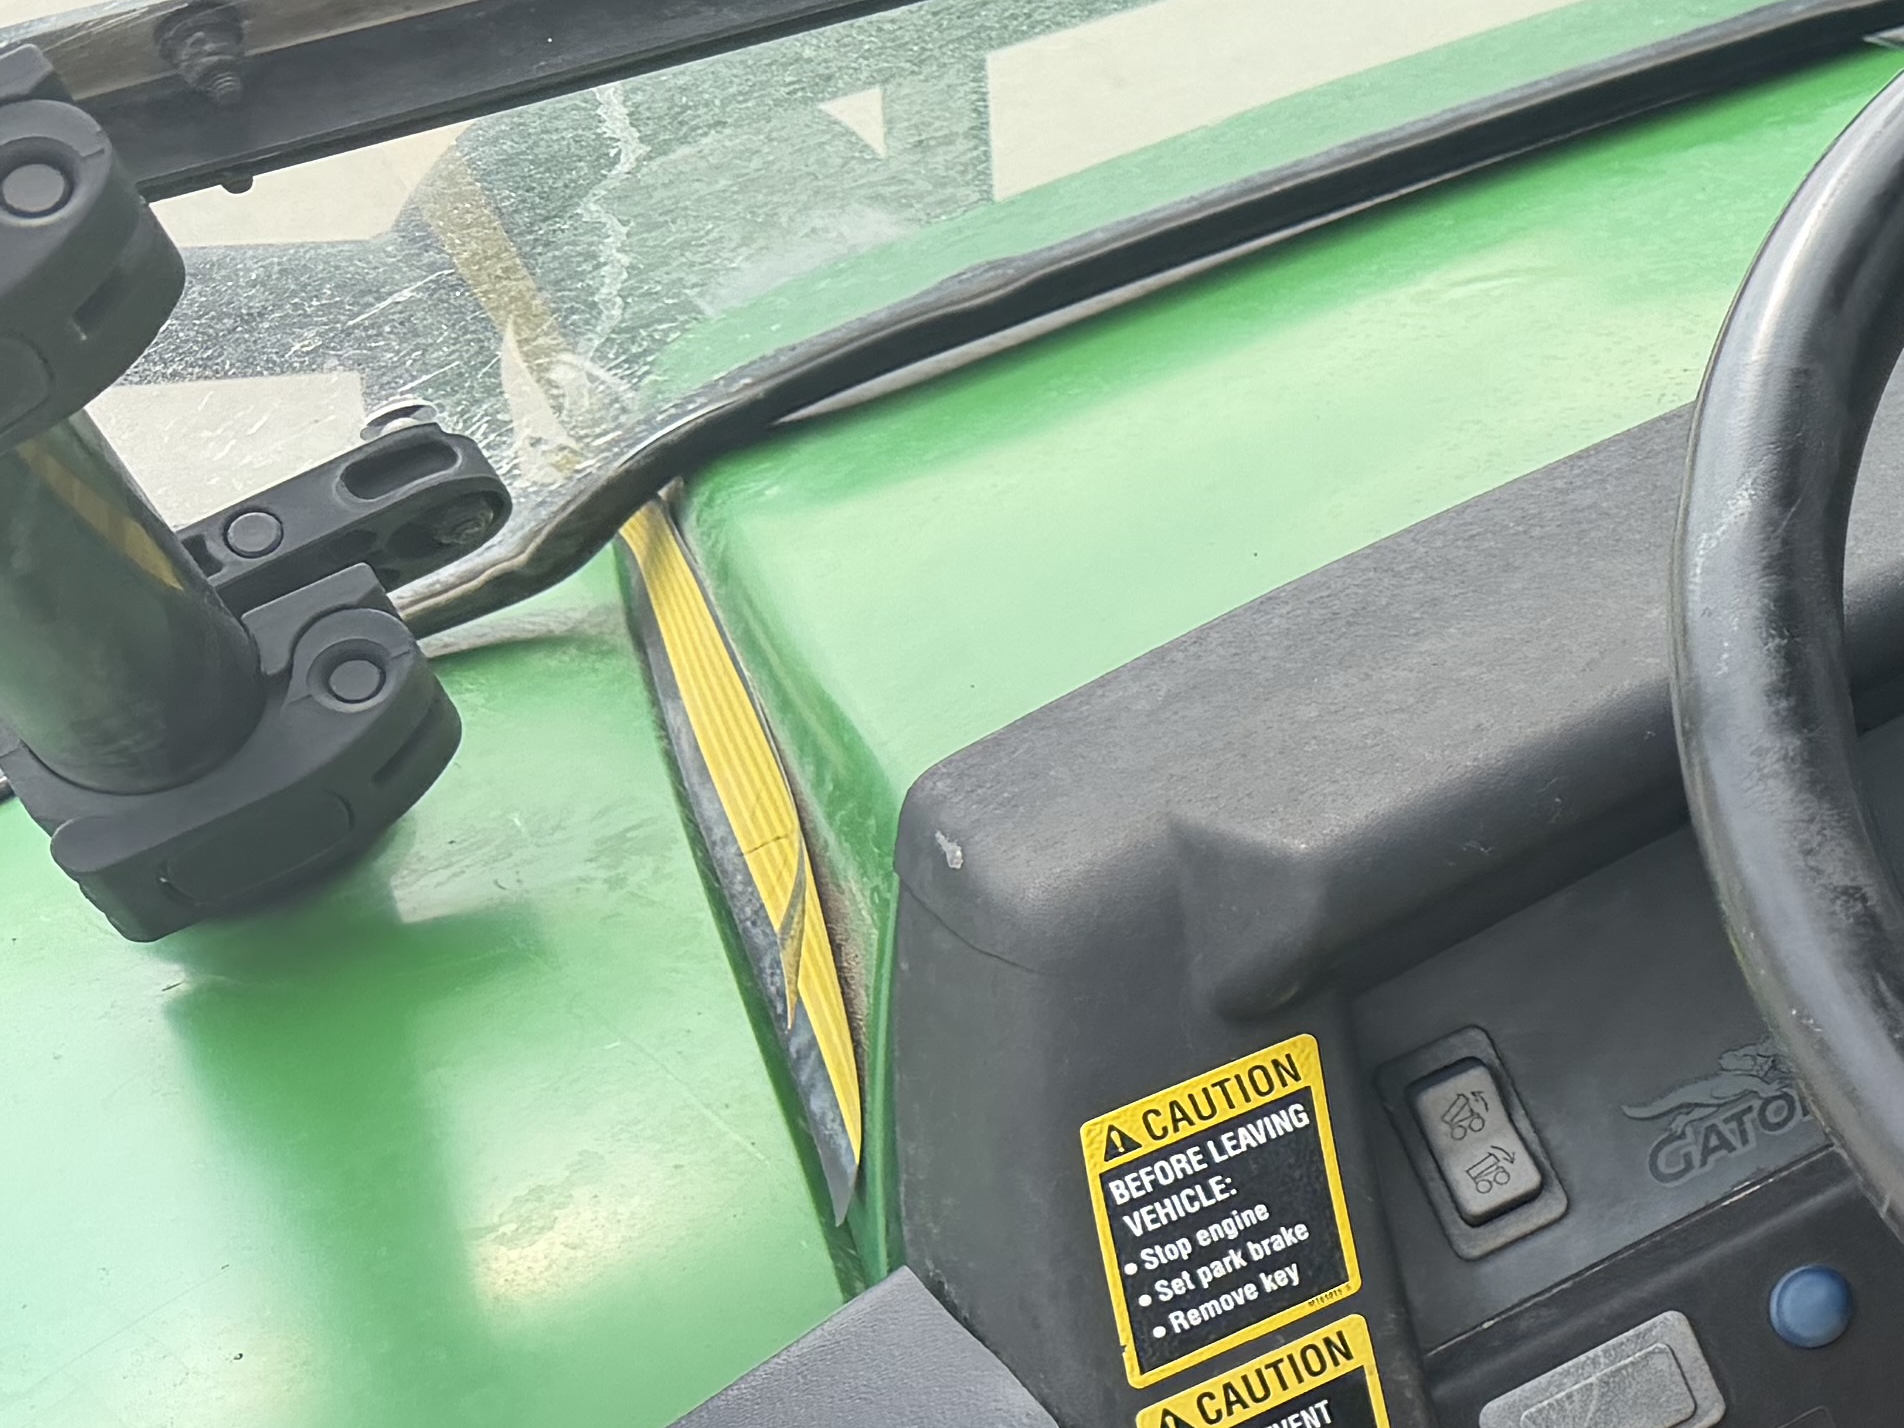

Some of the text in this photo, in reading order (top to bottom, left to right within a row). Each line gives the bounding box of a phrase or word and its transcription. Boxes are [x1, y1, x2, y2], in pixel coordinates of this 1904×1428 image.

[1141, 1051, 1301, 1143] CAUTION
[1649, 1090, 1812, 1183] GATO
[1109, 1101, 1309, 1206] BEFORE LEAVING
[1123, 1171, 1236, 1239] VEHICLE:
[1140, 1198, 1269, 1271] Stop engine
[1154, 1218, 1309, 1302] Set park brake
[1168, 1278, 1259, 1334] Remove
[1260, 1260, 1300, 1293] key
[1196, 1331, 1354, 1424] CAUTION
